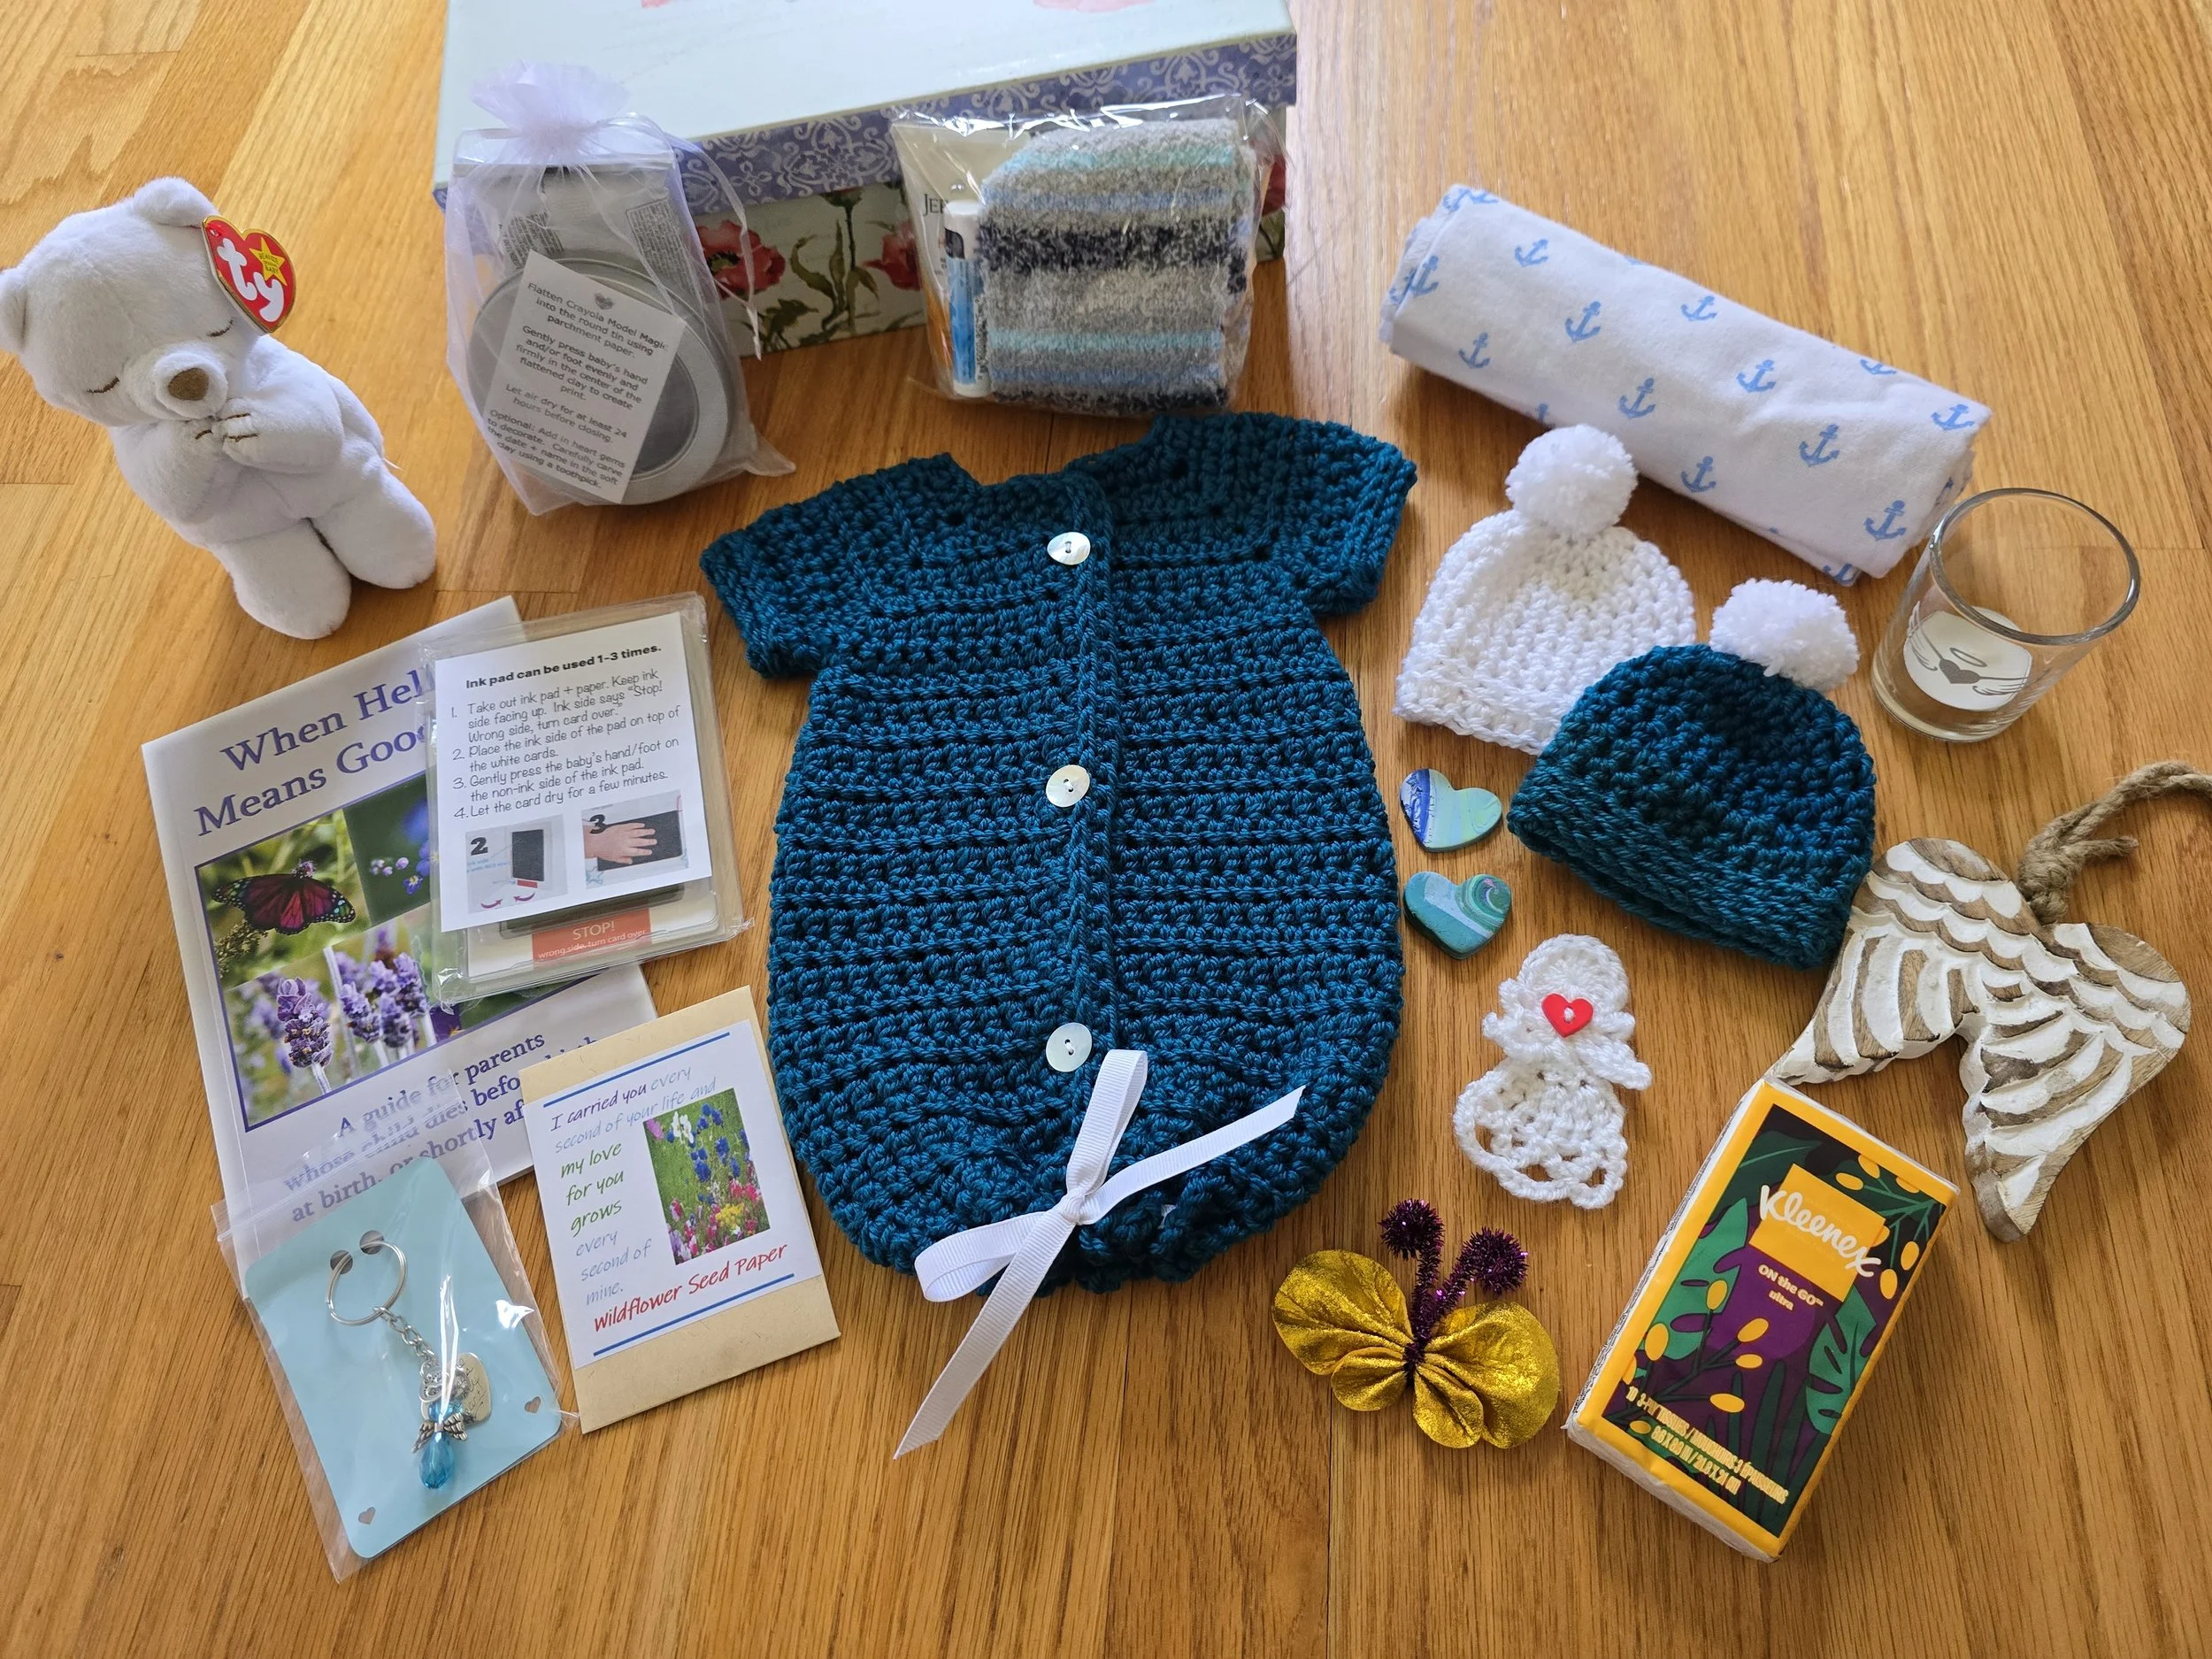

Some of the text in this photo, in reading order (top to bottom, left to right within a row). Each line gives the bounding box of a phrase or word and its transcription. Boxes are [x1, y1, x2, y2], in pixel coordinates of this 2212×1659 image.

[216, 237, 285, 323] ty
[527, 282, 564, 304] Flatten
[565, 300, 605, 323] Crayola
[607, 318, 638, 337] Model
[535, 296, 654, 357] into the round tin using
[522, 325, 649, 385] Gently press baby's hand
[547, 315, 635, 358] parchment paper.
[516, 343, 546, 363] firmly
[548, 357, 558, 367] in
[560, 363, 578, 376] the
[580, 372, 611, 389] center
[626, 391, 642, 404] the
[519, 357, 634, 411] flattened clay to create
[526, 338, 639, 391] and/or foot evenly and
[560, 385, 587, 401] print.
[466, 645, 662, 689] Ink pad can be used 1-3 times.
[467, 701, 496, 715] Take
[499, 696, 518, 710] out
[519, 691, 538, 704] ink
[540, 687, 560, 705] pad
[563, 686, 573, 695] +
[576, 681, 610, 698] paper.
[611, 674, 640, 688] Keep
[641, 668, 659, 680] ink
[468, 680, 663, 729] side facing up. Ink side says "Stop!
[219, 712, 348, 771] When
[468, 729, 505, 743] Wrong
[508, 722, 534, 736] side,
[537, 718, 560, 731] turn
[563, 710, 588, 726] card
[469, 744, 501, 758] Place
[503, 739, 522, 752] the
[524, 733, 542, 748] ink
[544, 729, 567, 744] side
[570, 725, 584, 739] of
[587, 723, 603, 735] the
[606, 716, 627, 735] pad
[629, 717, 644, 727] on
[646, 711, 665, 725] top
[668, 704, 680, 718] of
[452, 738, 680, 789] 3. Gently press the baby's hand/foot on
[469, 746, 559, 772] the white cards.
[470, 757, 644, 803] the non-ink side of the ink pad.
[193, 768, 327, 837] Means
[453, 771, 669, 819] 4. Let the card dry for a few minutes.
[470, 836, 488, 856] 2
[588, 813, 607, 834] 3
[538, 948, 566, 961] wrong
[607, 932, 626, 943] card
[627, 929, 646, 939] over
[572, 920, 615, 941] STOP!
[340, 1117, 355, 1137] A
[464, 1034, 545, 1086] parents
[550, 1066, 692, 1133] I carried you every
[555, 1075, 717, 1154] second of your life and
[560, 1143, 622, 1179] my love
[565, 1171, 624, 1207] for you
[292, 1202, 315, 1223] at
[570, 1200, 622, 1238] grows
[1759, 1184, 1882, 1278] Kleenex
[575, 1231, 618, 1257] every
[580, 1238, 652, 1282] second of
[688, 1260, 730, 1294] Seed
[733, 1244, 787, 1276] Paper
[1758, 1264, 1778, 1282] ON
[1778, 1275, 1798, 1294] the
[586, 1282, 624, 1306] mine.
[1769, 1290, 1793, 1310] ultra
